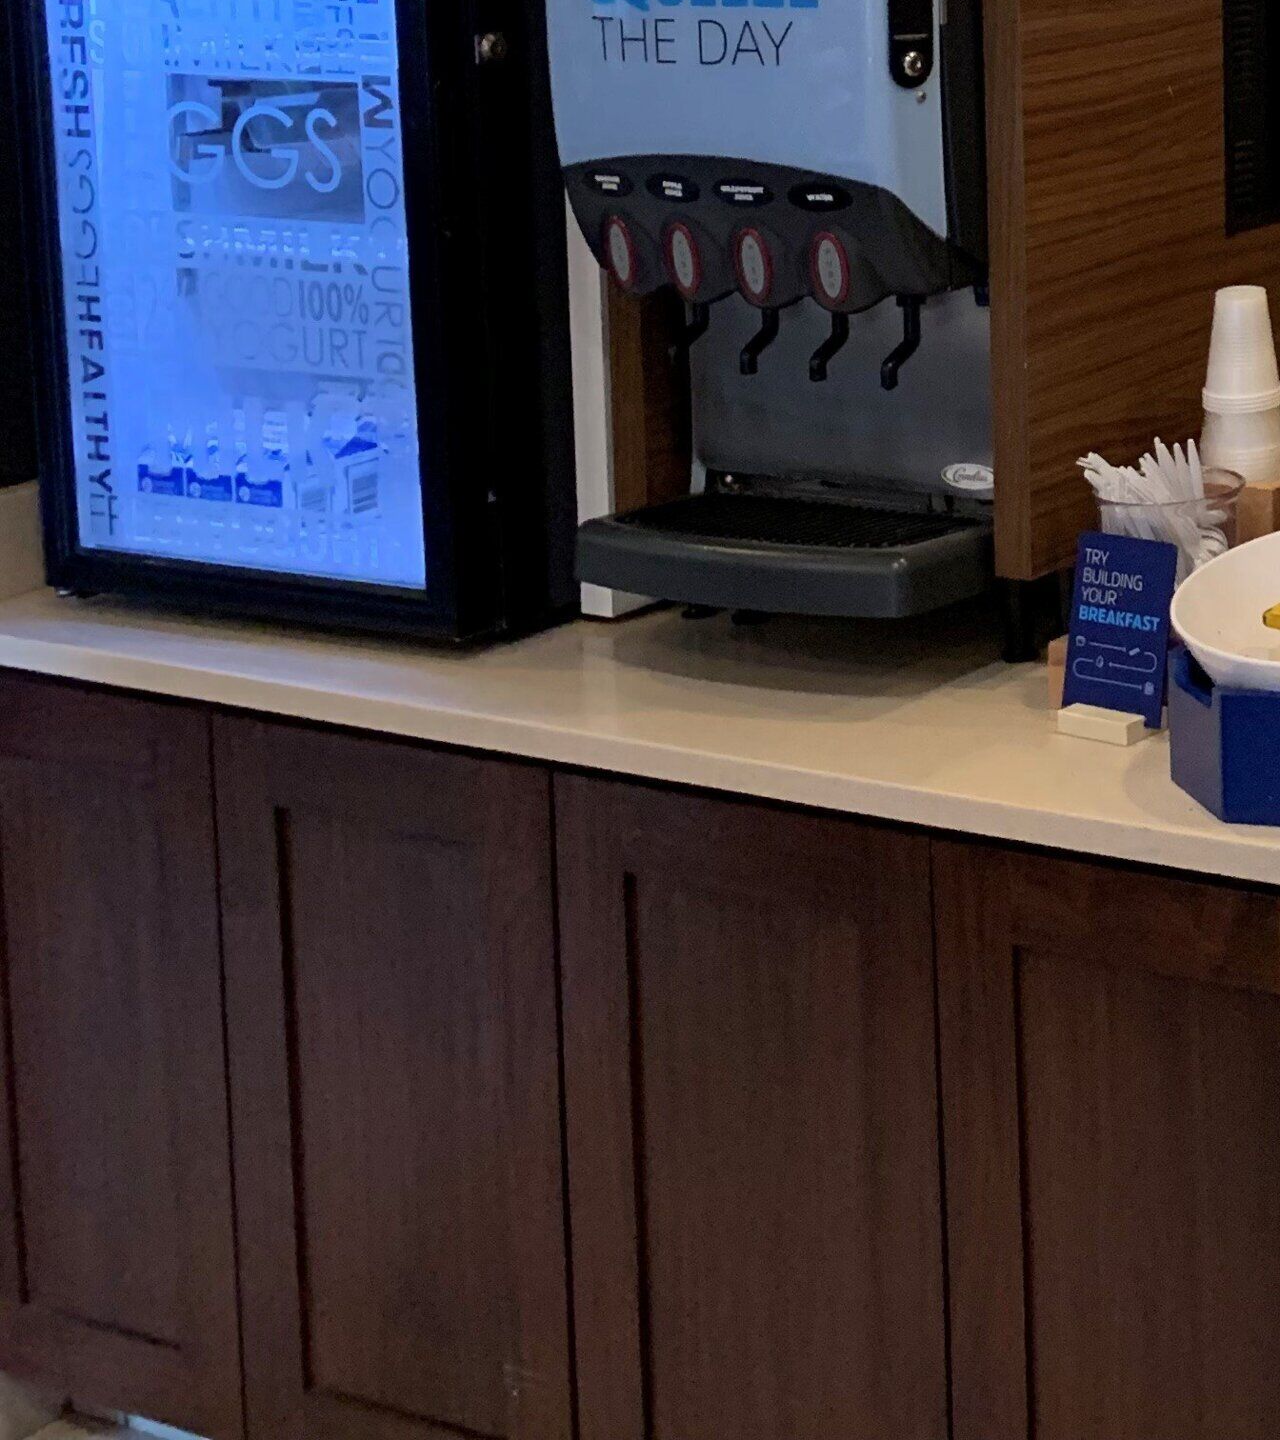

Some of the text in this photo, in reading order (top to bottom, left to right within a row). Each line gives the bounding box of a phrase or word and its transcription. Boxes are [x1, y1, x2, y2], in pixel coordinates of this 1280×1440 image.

[591, 16, 793, 66] THE DAY
[167, 101, 342, 194] GGS
[297, 279, 369, 326] 100%
[1085, 548, 1110, 565] TRY
[1083, 567, 1143, 591] BUILDING
[1081, 586, 1118, 605] YOUR
[1078, 605, 1161, 632] BREAKFAST
